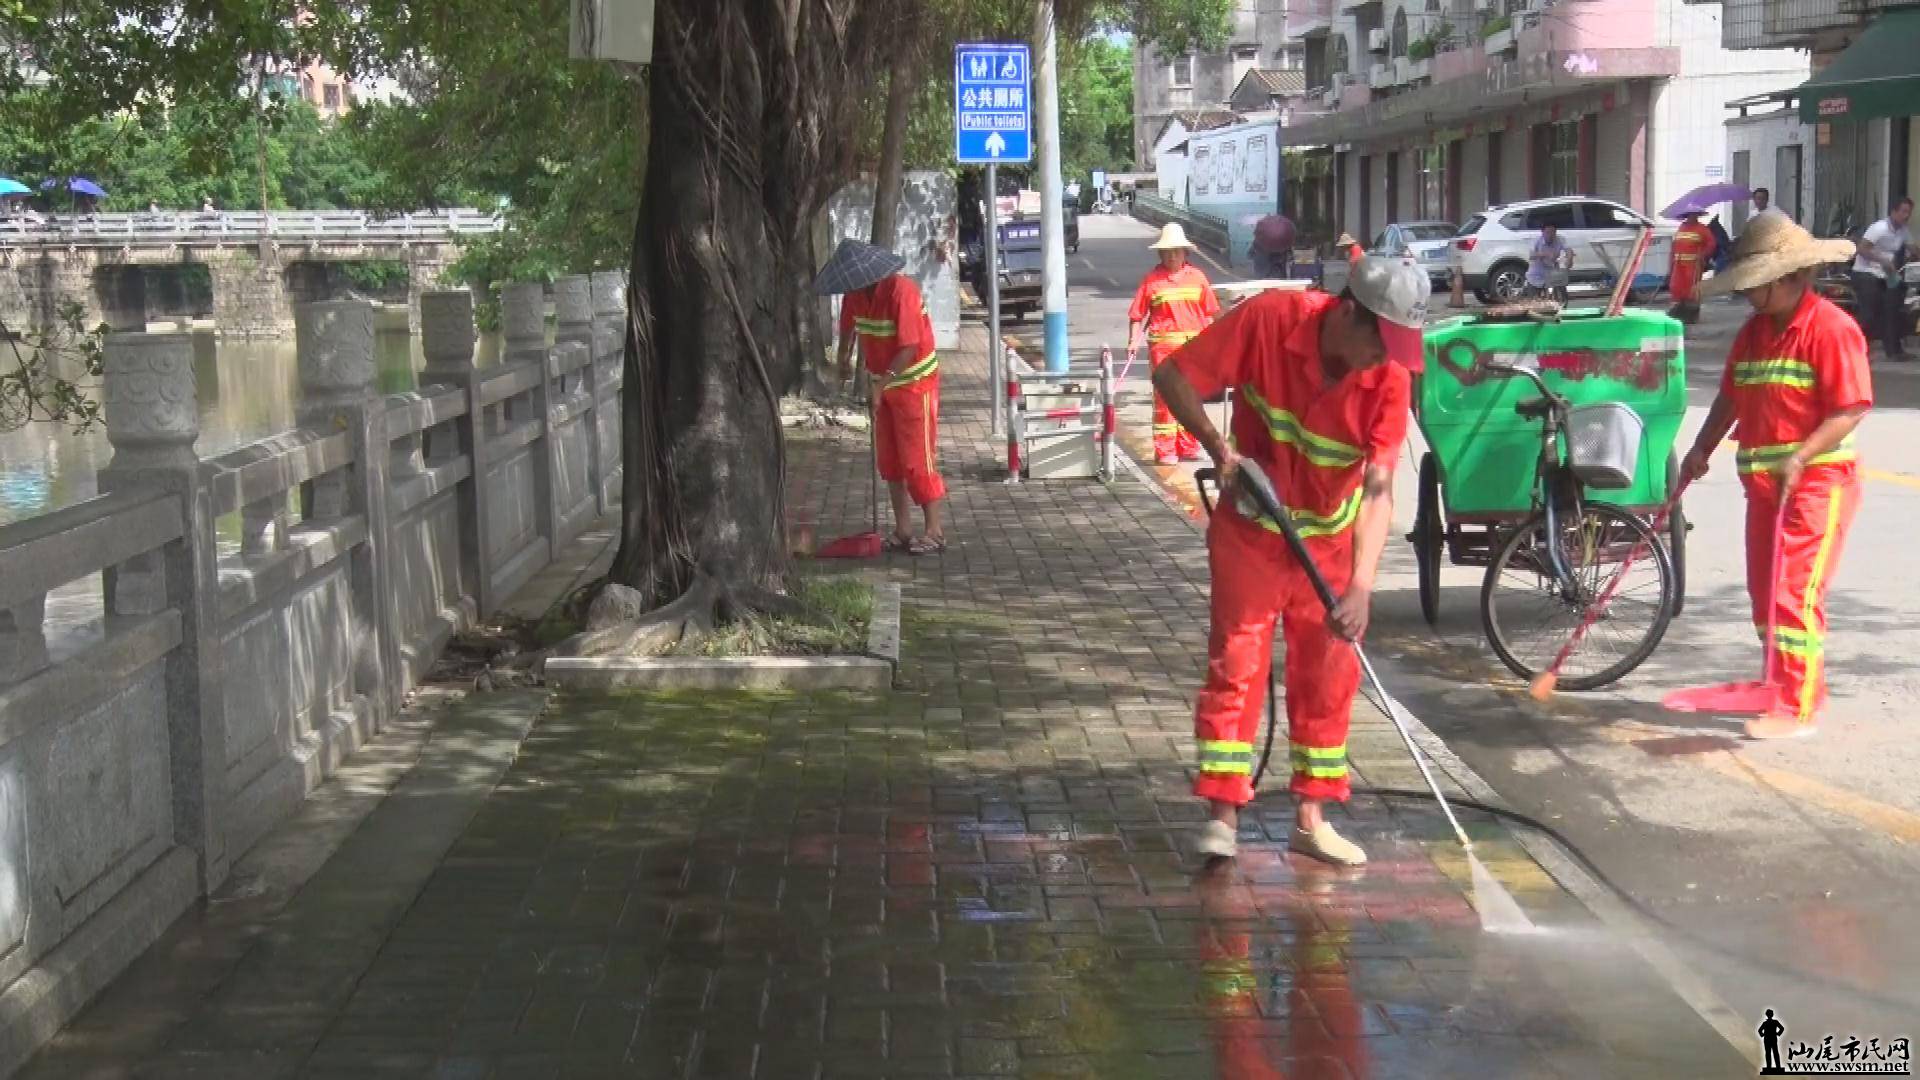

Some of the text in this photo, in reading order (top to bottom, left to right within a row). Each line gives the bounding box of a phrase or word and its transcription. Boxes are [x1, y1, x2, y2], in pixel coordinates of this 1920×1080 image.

[962, 87, 1024, 108] 公共厕所
[965, 115, 1023, 128] Public toilets
